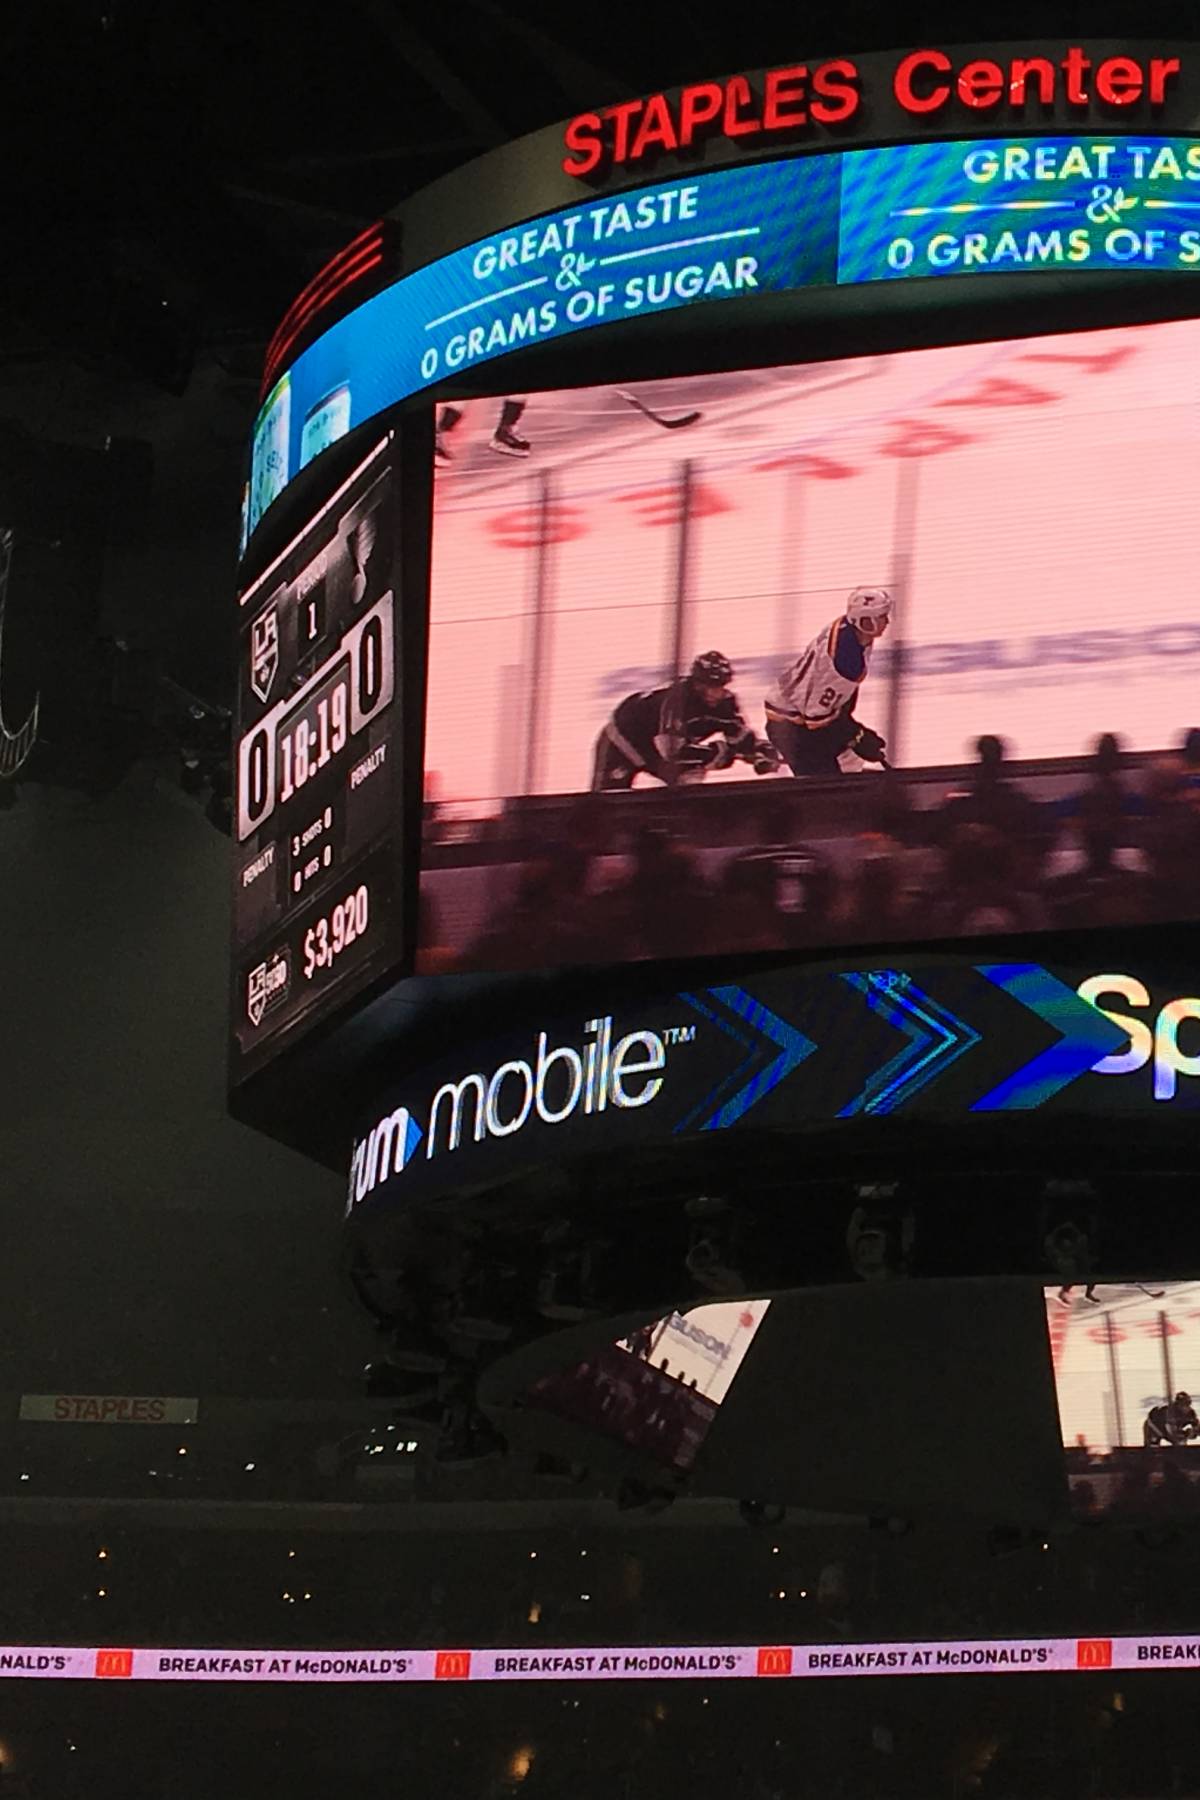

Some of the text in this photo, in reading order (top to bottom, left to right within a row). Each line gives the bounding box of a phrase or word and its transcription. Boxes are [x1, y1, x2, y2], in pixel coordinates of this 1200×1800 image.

[562, 47, 1180, 178] STAPLES Center
[963, 145, 1117, 184] GREAT
[1085, 184, 1134, 223] &
[471, 184, 701, 280] GREAT TASTE
[887, 236, 914, 270] 0
[927, 229, 1091, 263] GRAMS
[1104, 229, 1166, 261] OF
[555, 252, 593, 292] &
[420, 256, 760, 380] 0 GRAMS OF SUGAR
[308, 602, 318, 640] 1
[248, 614, 383, 822] 0 18:19 0
[351, 744, 387, 790] PENALTY
[292, 835, 301, 857] 3
[324, 806, 332, 829] 0
[243, 846, 275, 888] PENALTY
[293, 871, 301, 893] 0
[323, 844, 332, 867] 0
[303, 884, 369, 980] $3,920
[54, 1397, 166, 1422] STAPLES
[159, 1657, 265, 1674] BREAKFAST
[268, 1658, 293, 1674] AT
[495, 1656, 595, 1673] BREAKFAST
[597, 1656, 621, 1672] AT
[808, 1651, 908, 1670] BREAKFAST
[911, 1651, 934, 1668] AT
